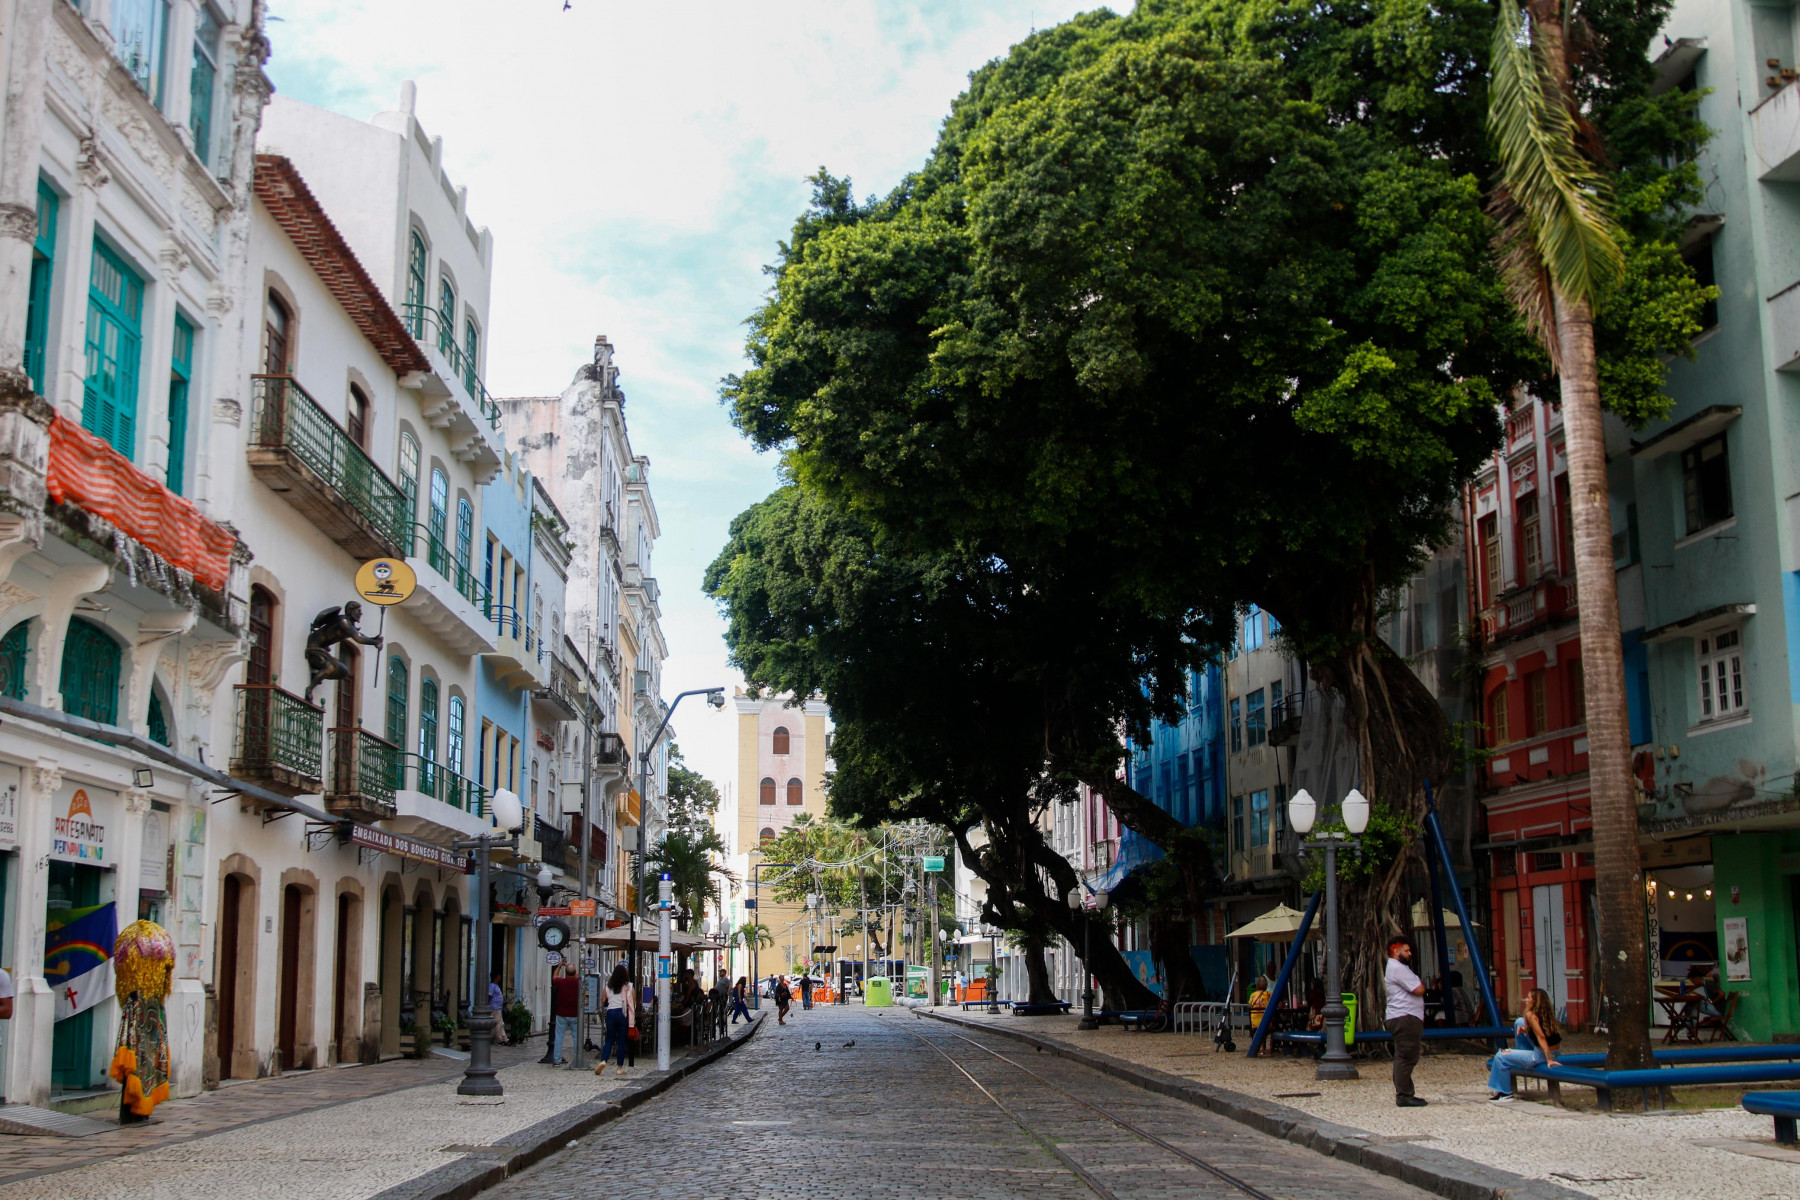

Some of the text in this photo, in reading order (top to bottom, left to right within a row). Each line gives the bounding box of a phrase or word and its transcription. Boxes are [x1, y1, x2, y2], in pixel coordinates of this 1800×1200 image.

[55, 816, 105, 843] ARTESANATO
[54, 839, 104, 861] PERNAMBUCANO
[353, 825, 393, 847] EMBAIXADA
[395, 839, 409, 852] DOS
[411, 843, 439, 860] BONECOS
[441, 851, 467, 868] GIGATES
[1649, 919, 1658, 937] DE
[1650, 941, 1660, 979] ROLO
